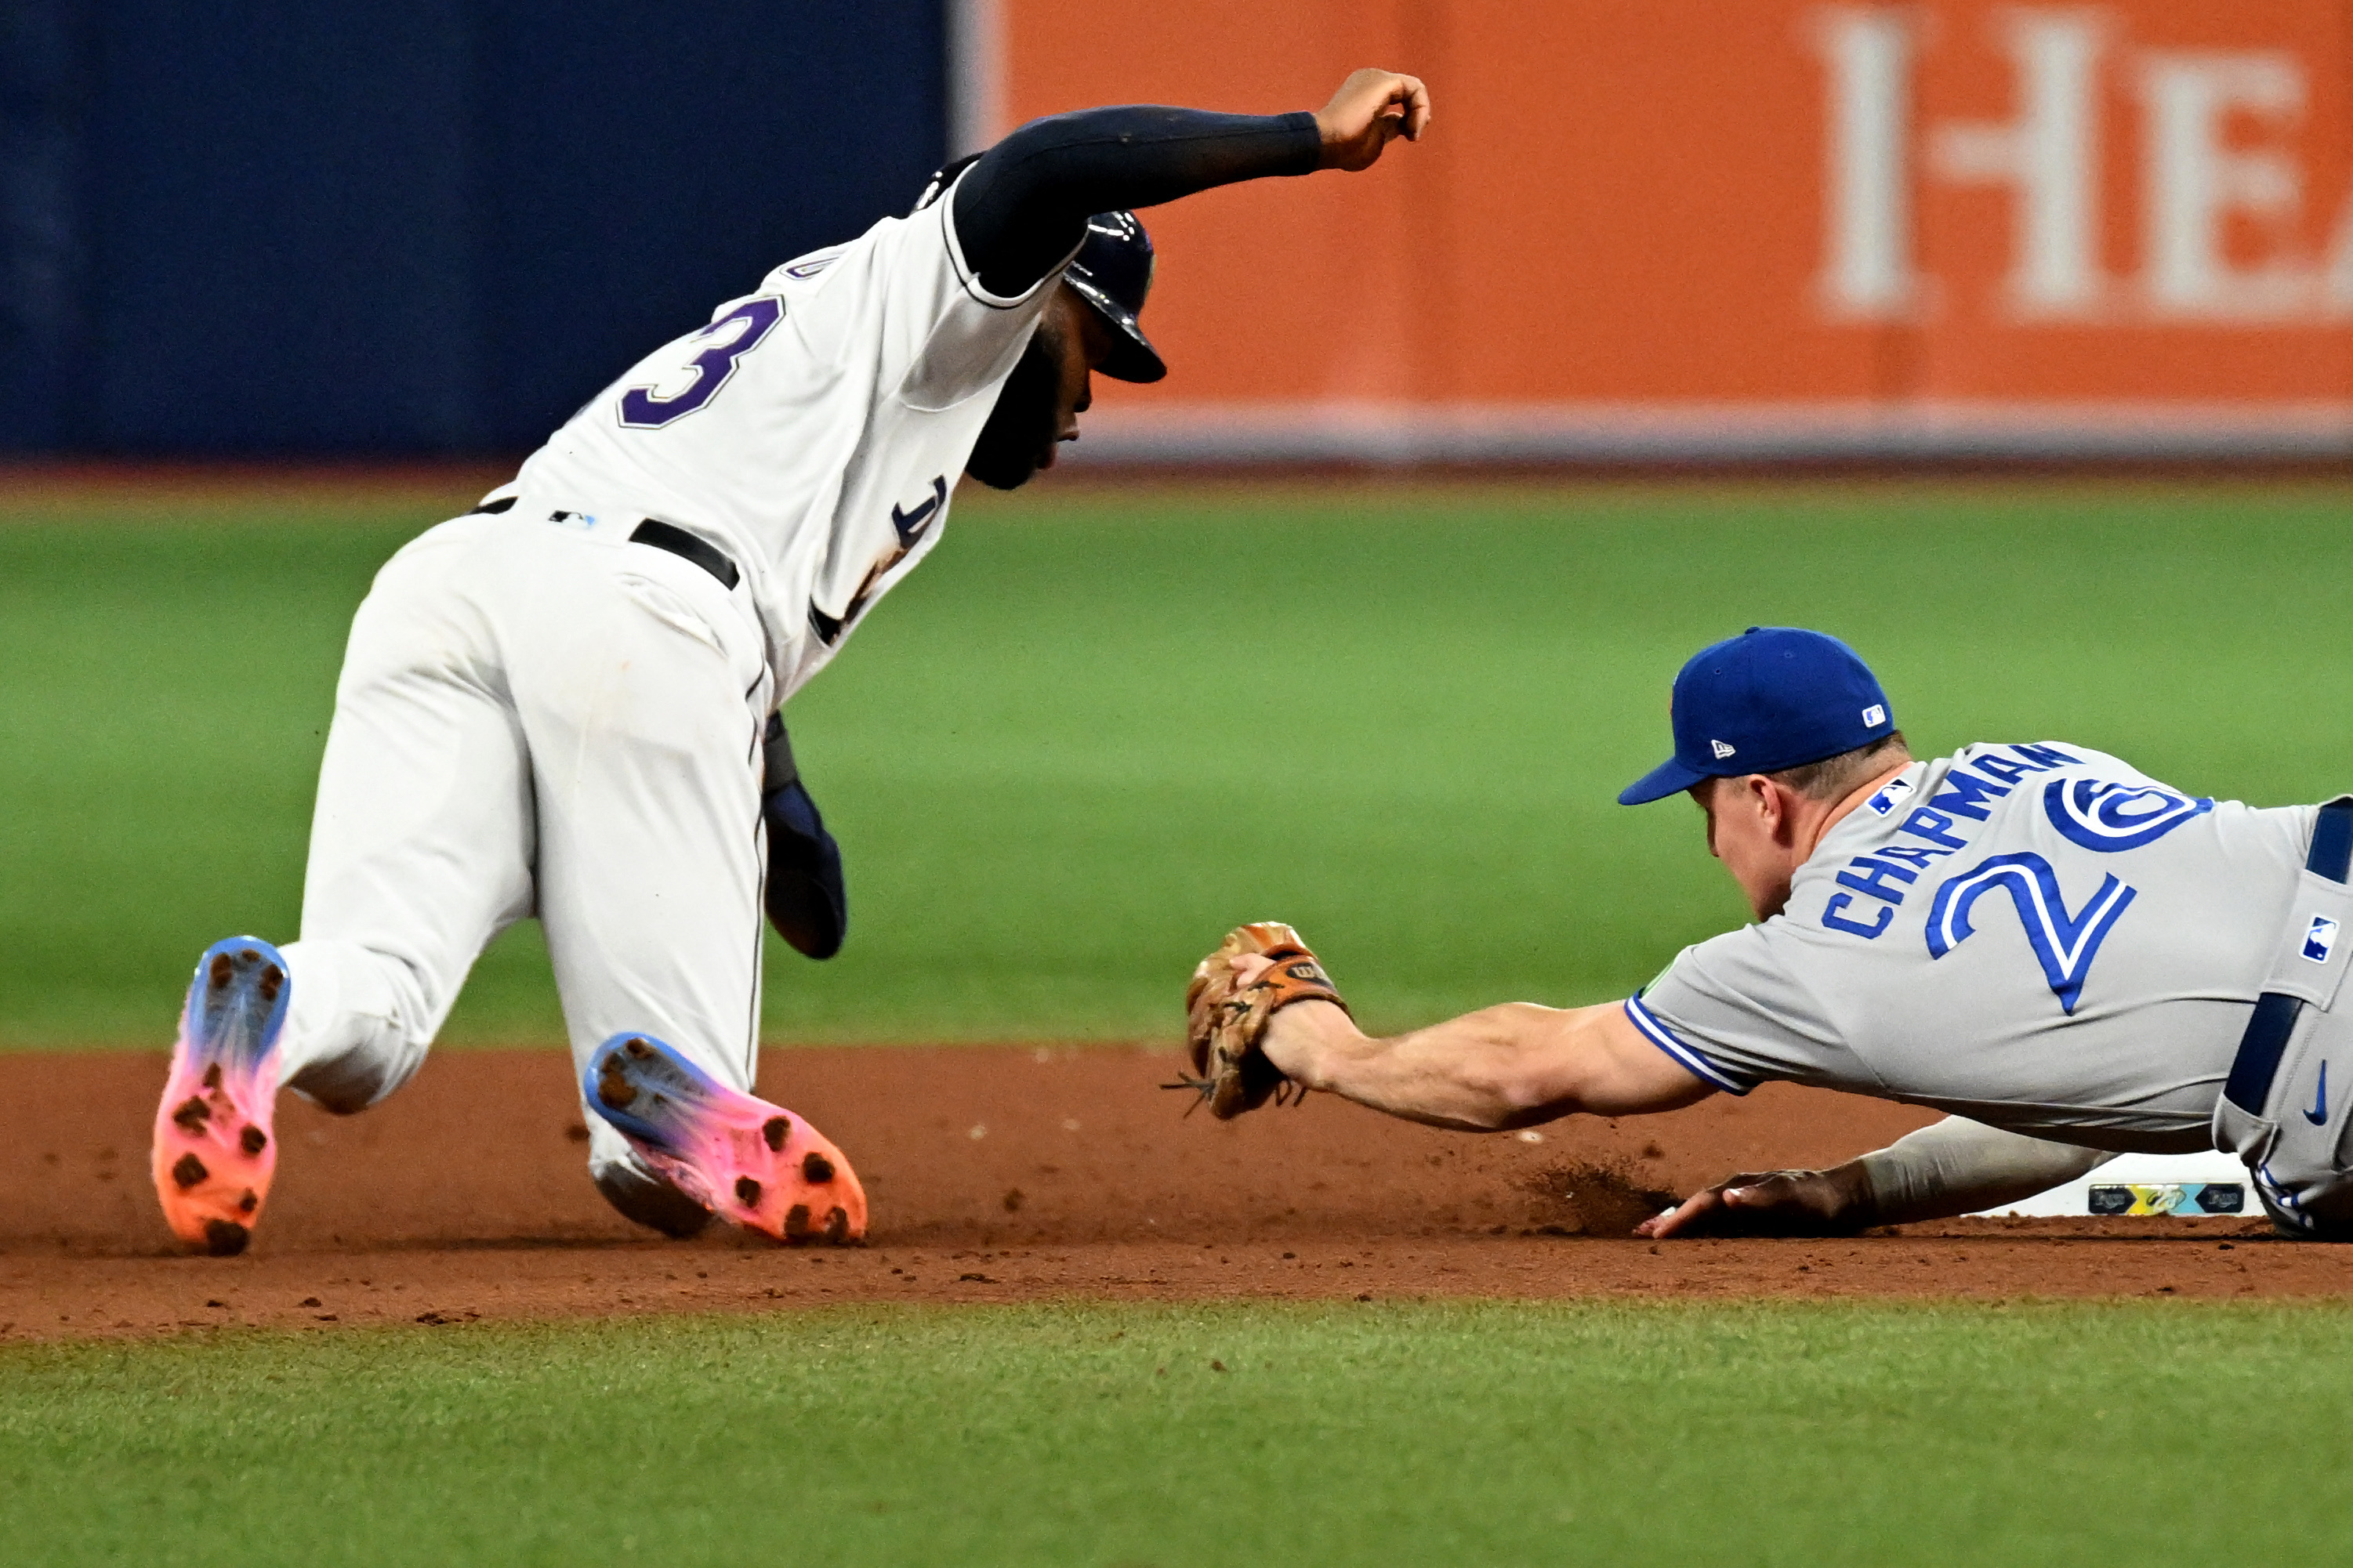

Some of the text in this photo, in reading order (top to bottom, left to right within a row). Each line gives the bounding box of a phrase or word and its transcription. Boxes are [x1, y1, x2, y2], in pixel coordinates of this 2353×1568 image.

[1812, 6, 2353, 321] HE
[615, 293, 787, 430] 3
[1822, 744, 2087, 940] CHAPMAN
[1925, 777, 2214, 1016] 26
